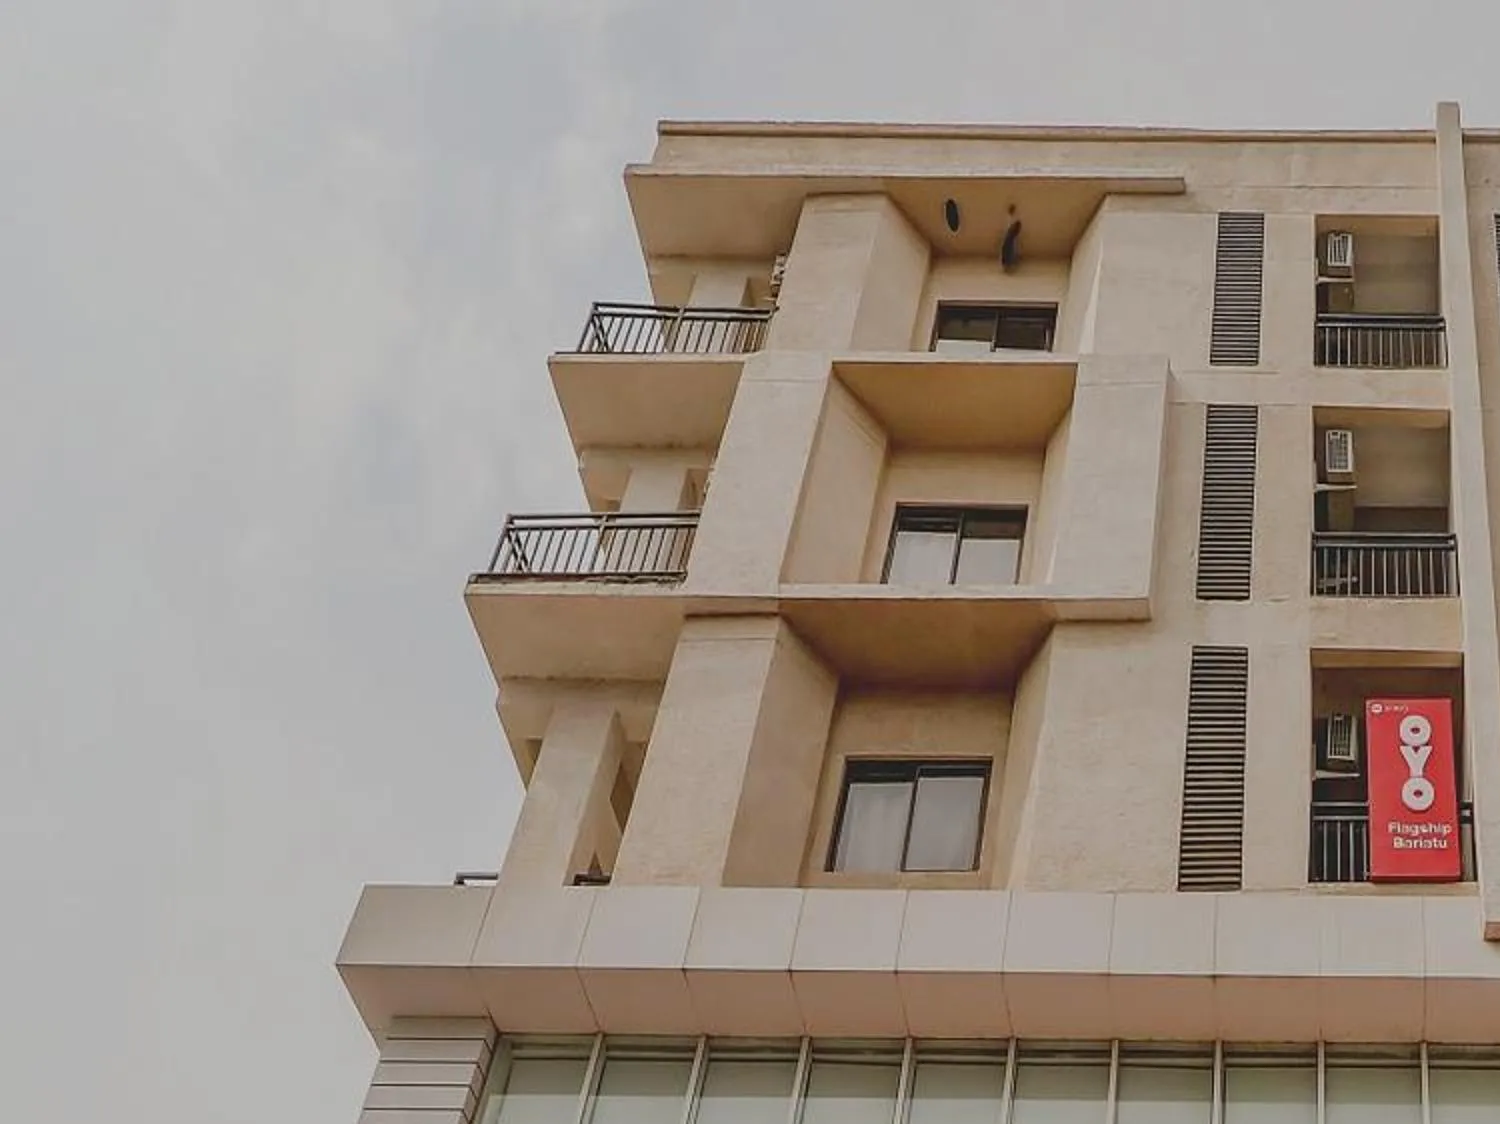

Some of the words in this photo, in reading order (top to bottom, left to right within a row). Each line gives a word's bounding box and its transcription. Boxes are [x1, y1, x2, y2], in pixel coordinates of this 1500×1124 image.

[1399, 715, 1435, 811] OYO
[1388, 822, 1451, 836] Flagship
[1393, 836, 1447, 849] Bariatu
